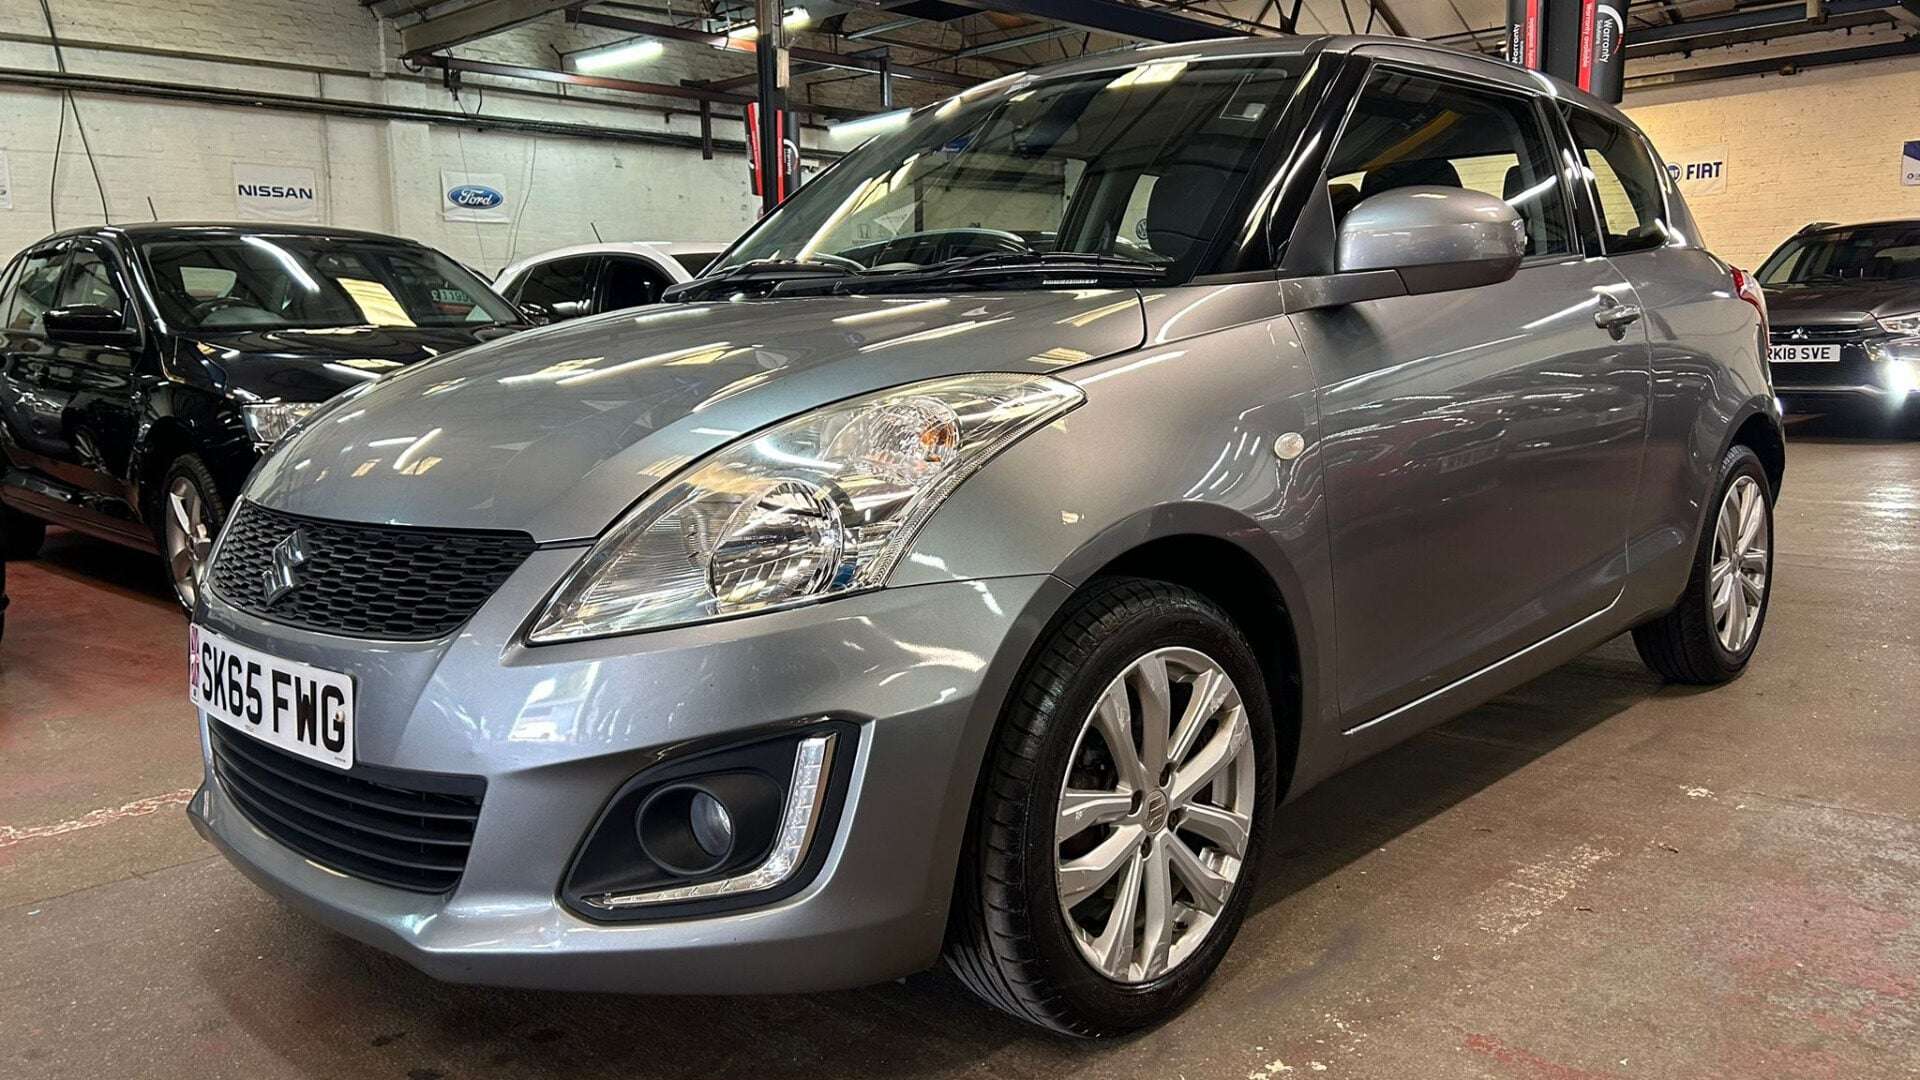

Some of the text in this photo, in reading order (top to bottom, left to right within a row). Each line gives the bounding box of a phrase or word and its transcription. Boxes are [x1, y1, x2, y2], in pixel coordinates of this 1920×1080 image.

[1600, 18, 1613, 63] Warranty
[1686, 161, 1723, 180] FIAT
[238, 184, 313, 200] NISSAN
[458, 189, 493, 206] Ford
[1800, 347, 1831, 360] SVE
[202, 641, 345, 753] SK65 FWG
